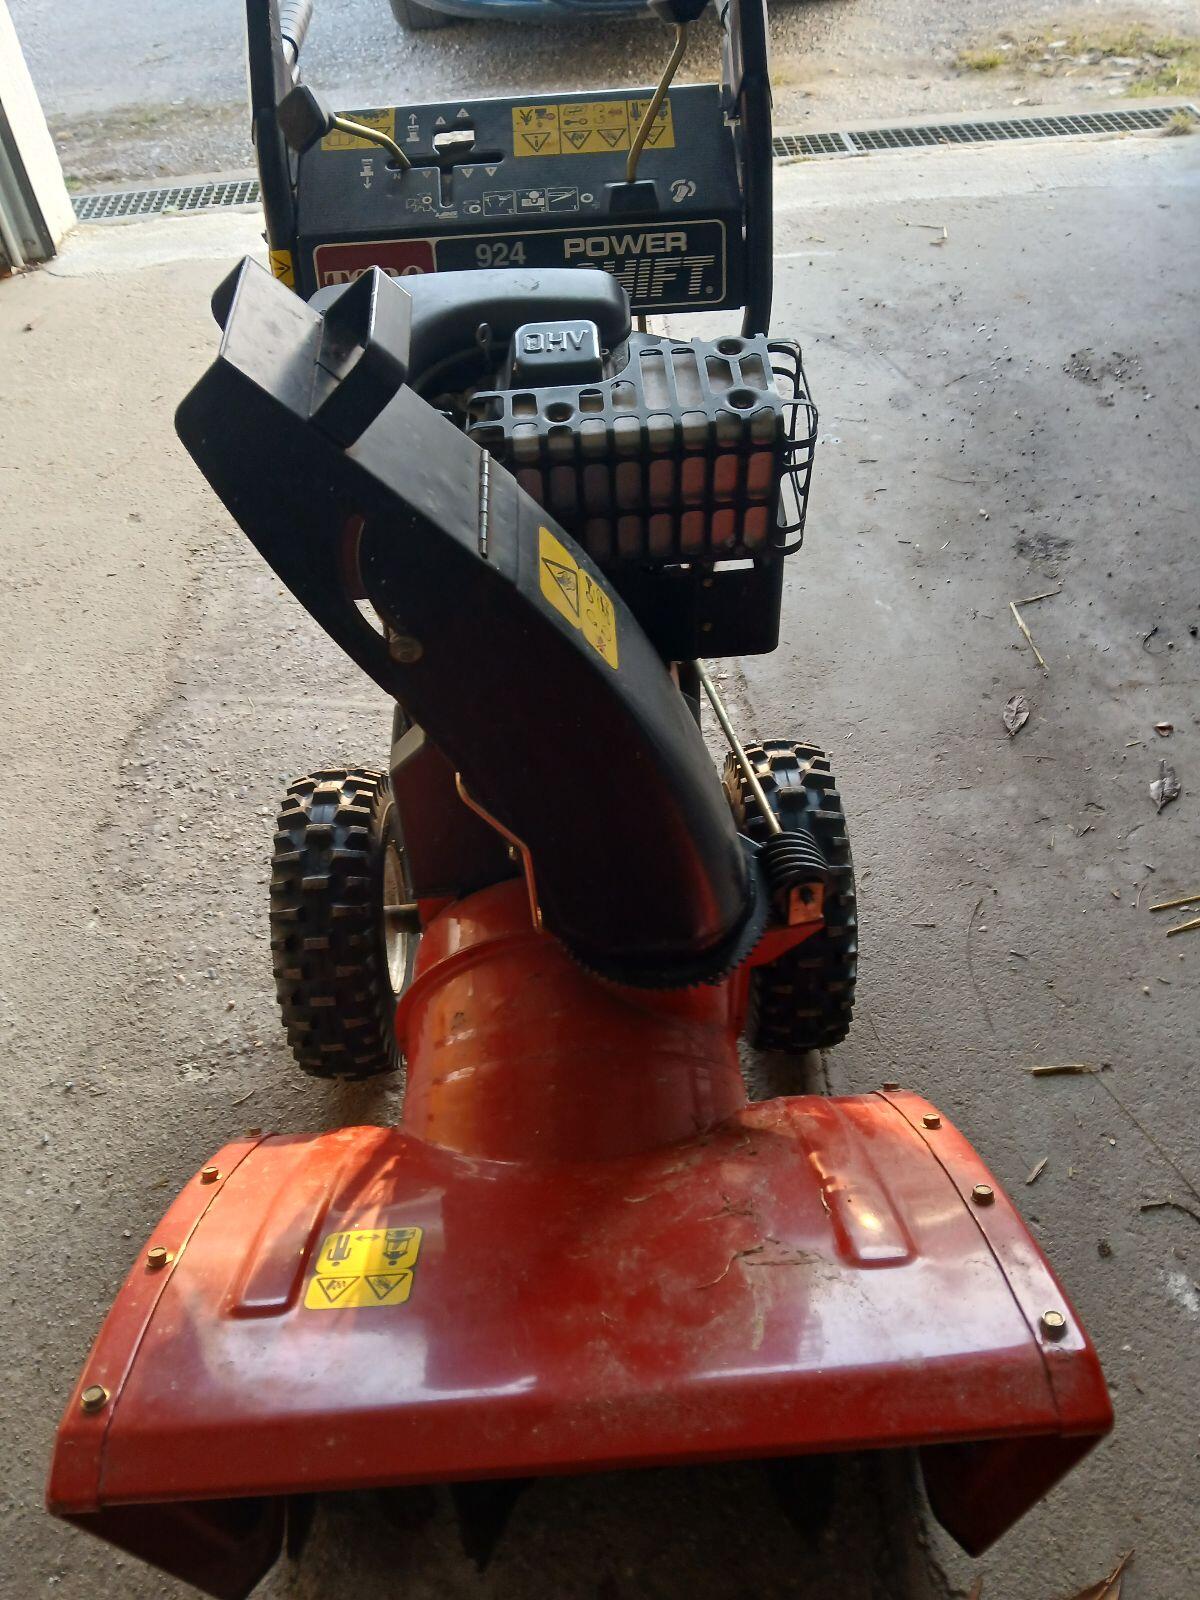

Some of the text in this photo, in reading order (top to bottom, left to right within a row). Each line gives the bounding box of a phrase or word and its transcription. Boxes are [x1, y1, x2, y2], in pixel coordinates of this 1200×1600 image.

[475, 241, 526, 267] 924
[563, 231, 688, 259] POWER
[576, 255, 715, 298] HIFT
[523, 329, 590, 354] OHV
